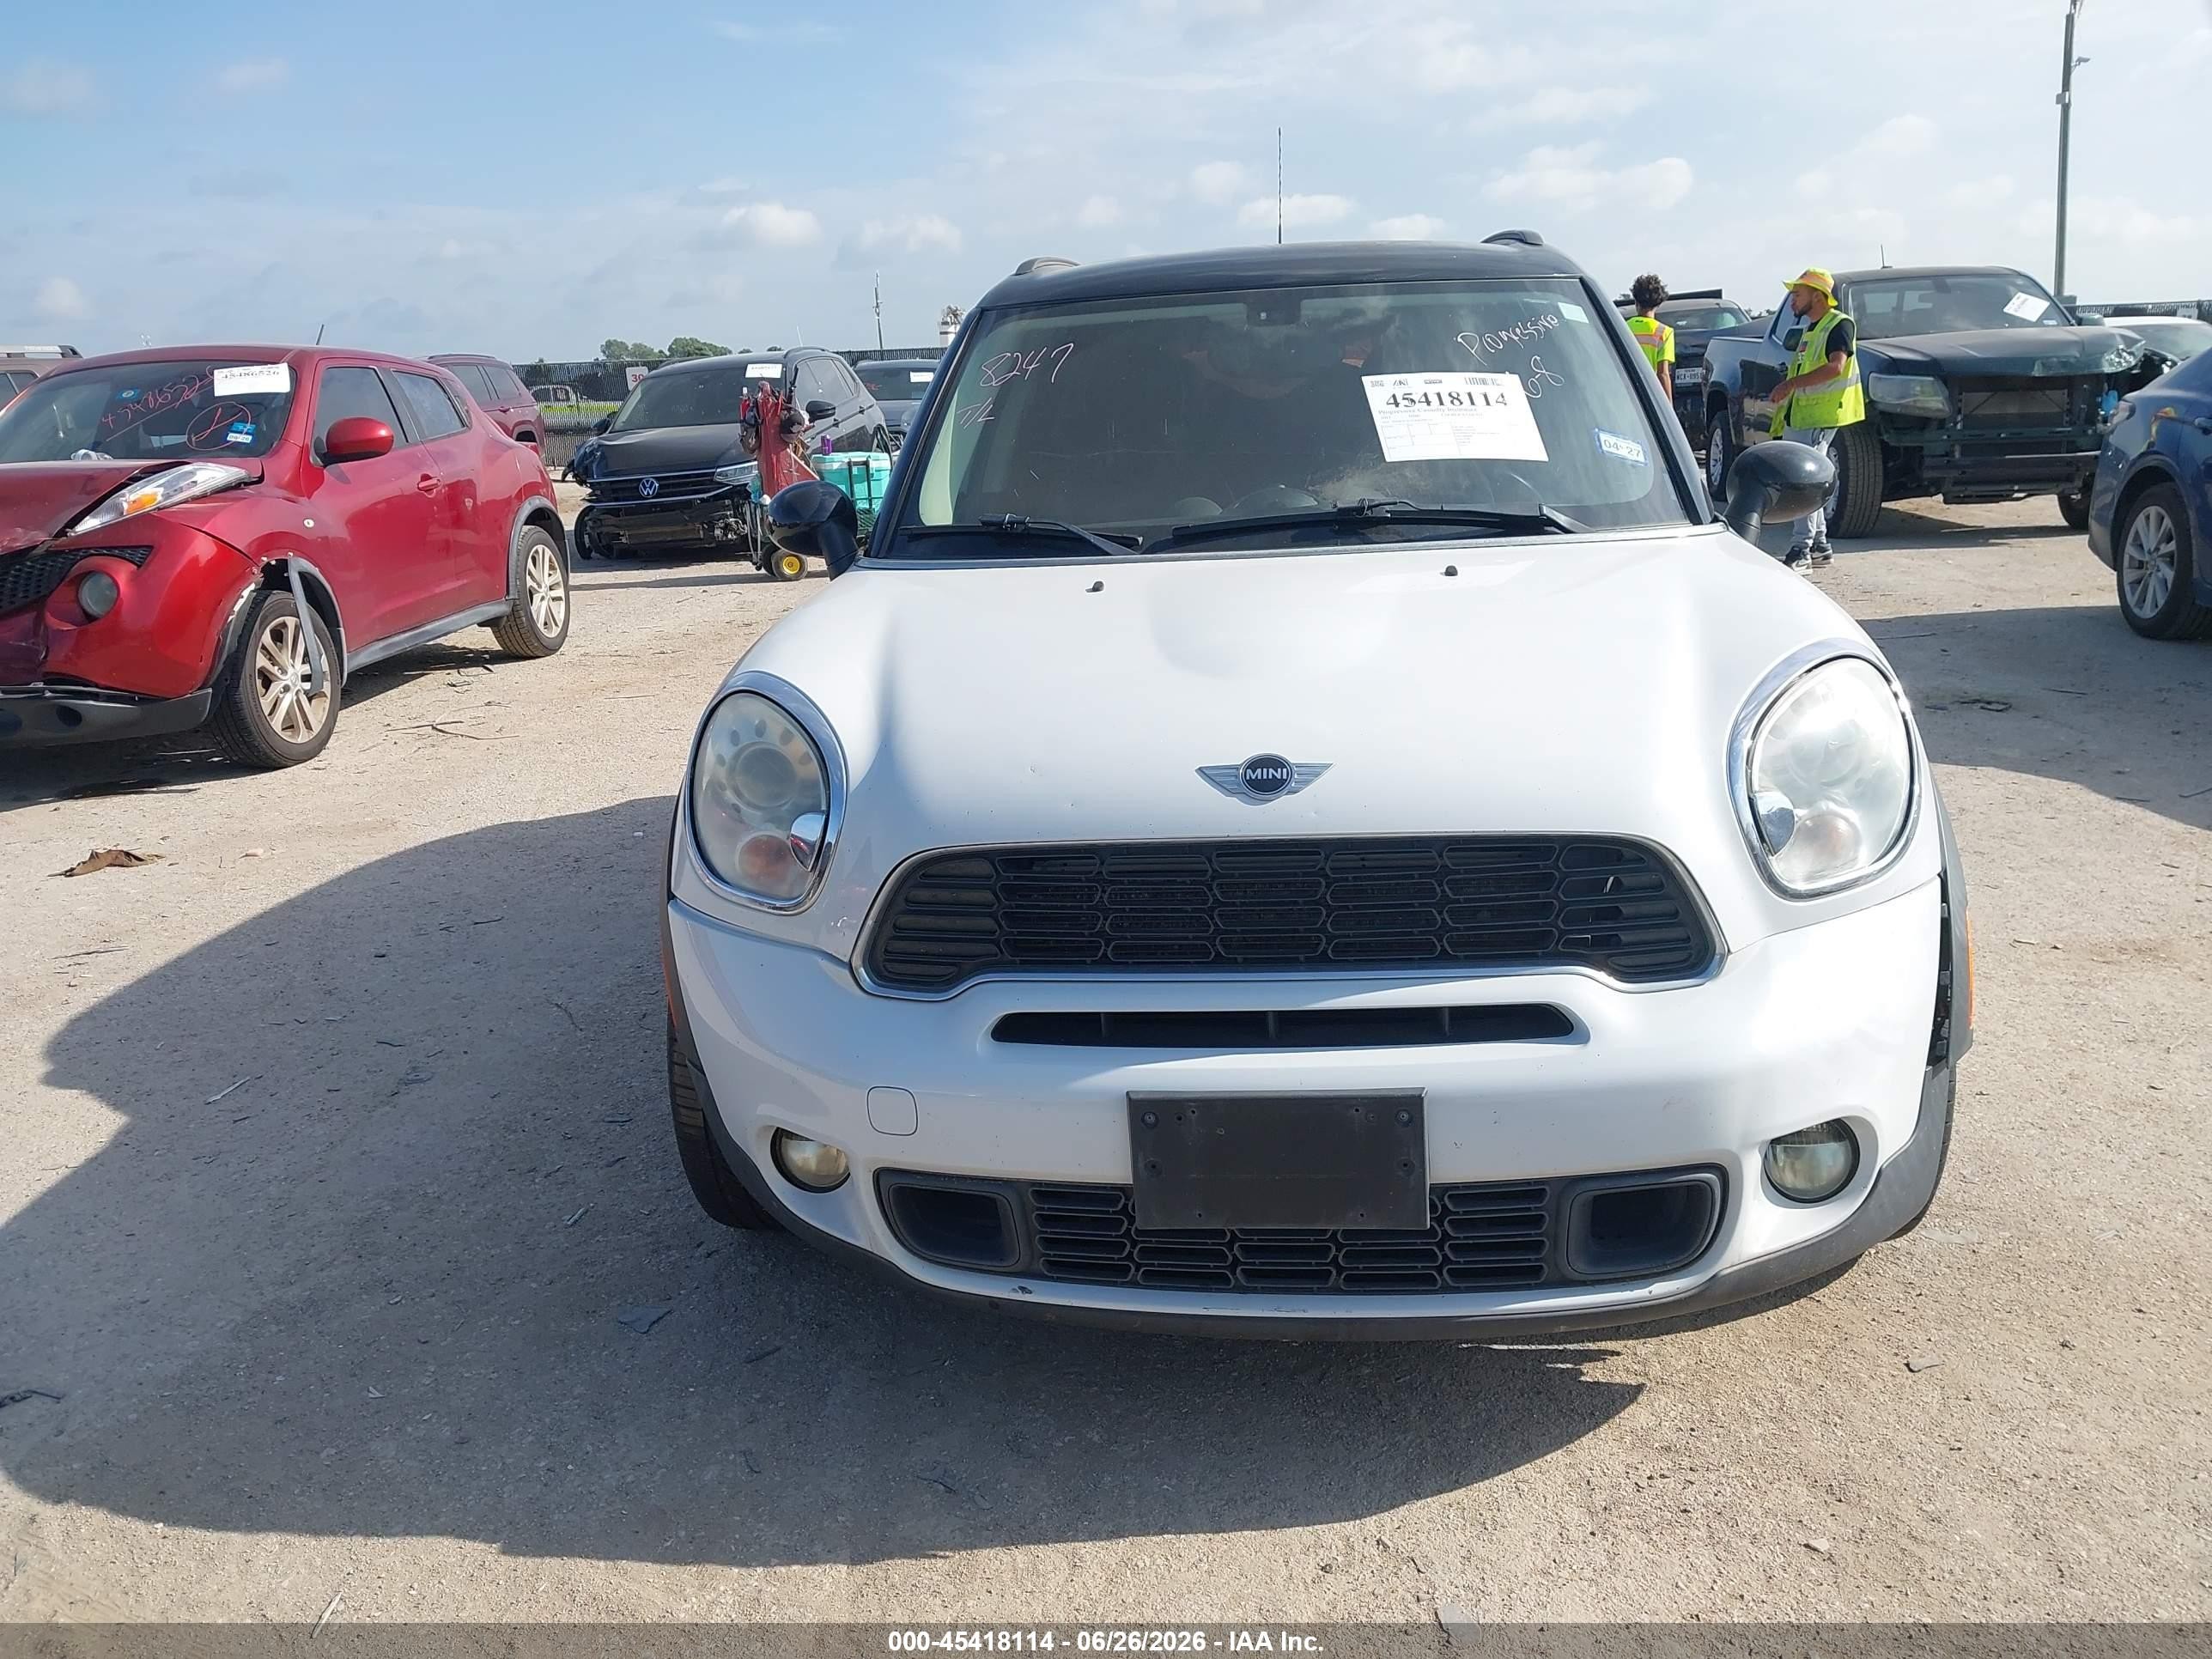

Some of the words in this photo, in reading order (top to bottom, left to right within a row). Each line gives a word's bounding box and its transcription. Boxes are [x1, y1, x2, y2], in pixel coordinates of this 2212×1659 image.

[980, 343, 1074, 386] 8247
[1386, 391, 1507, 408] 45418114
[1246, 768, 1288, 780] MINI
